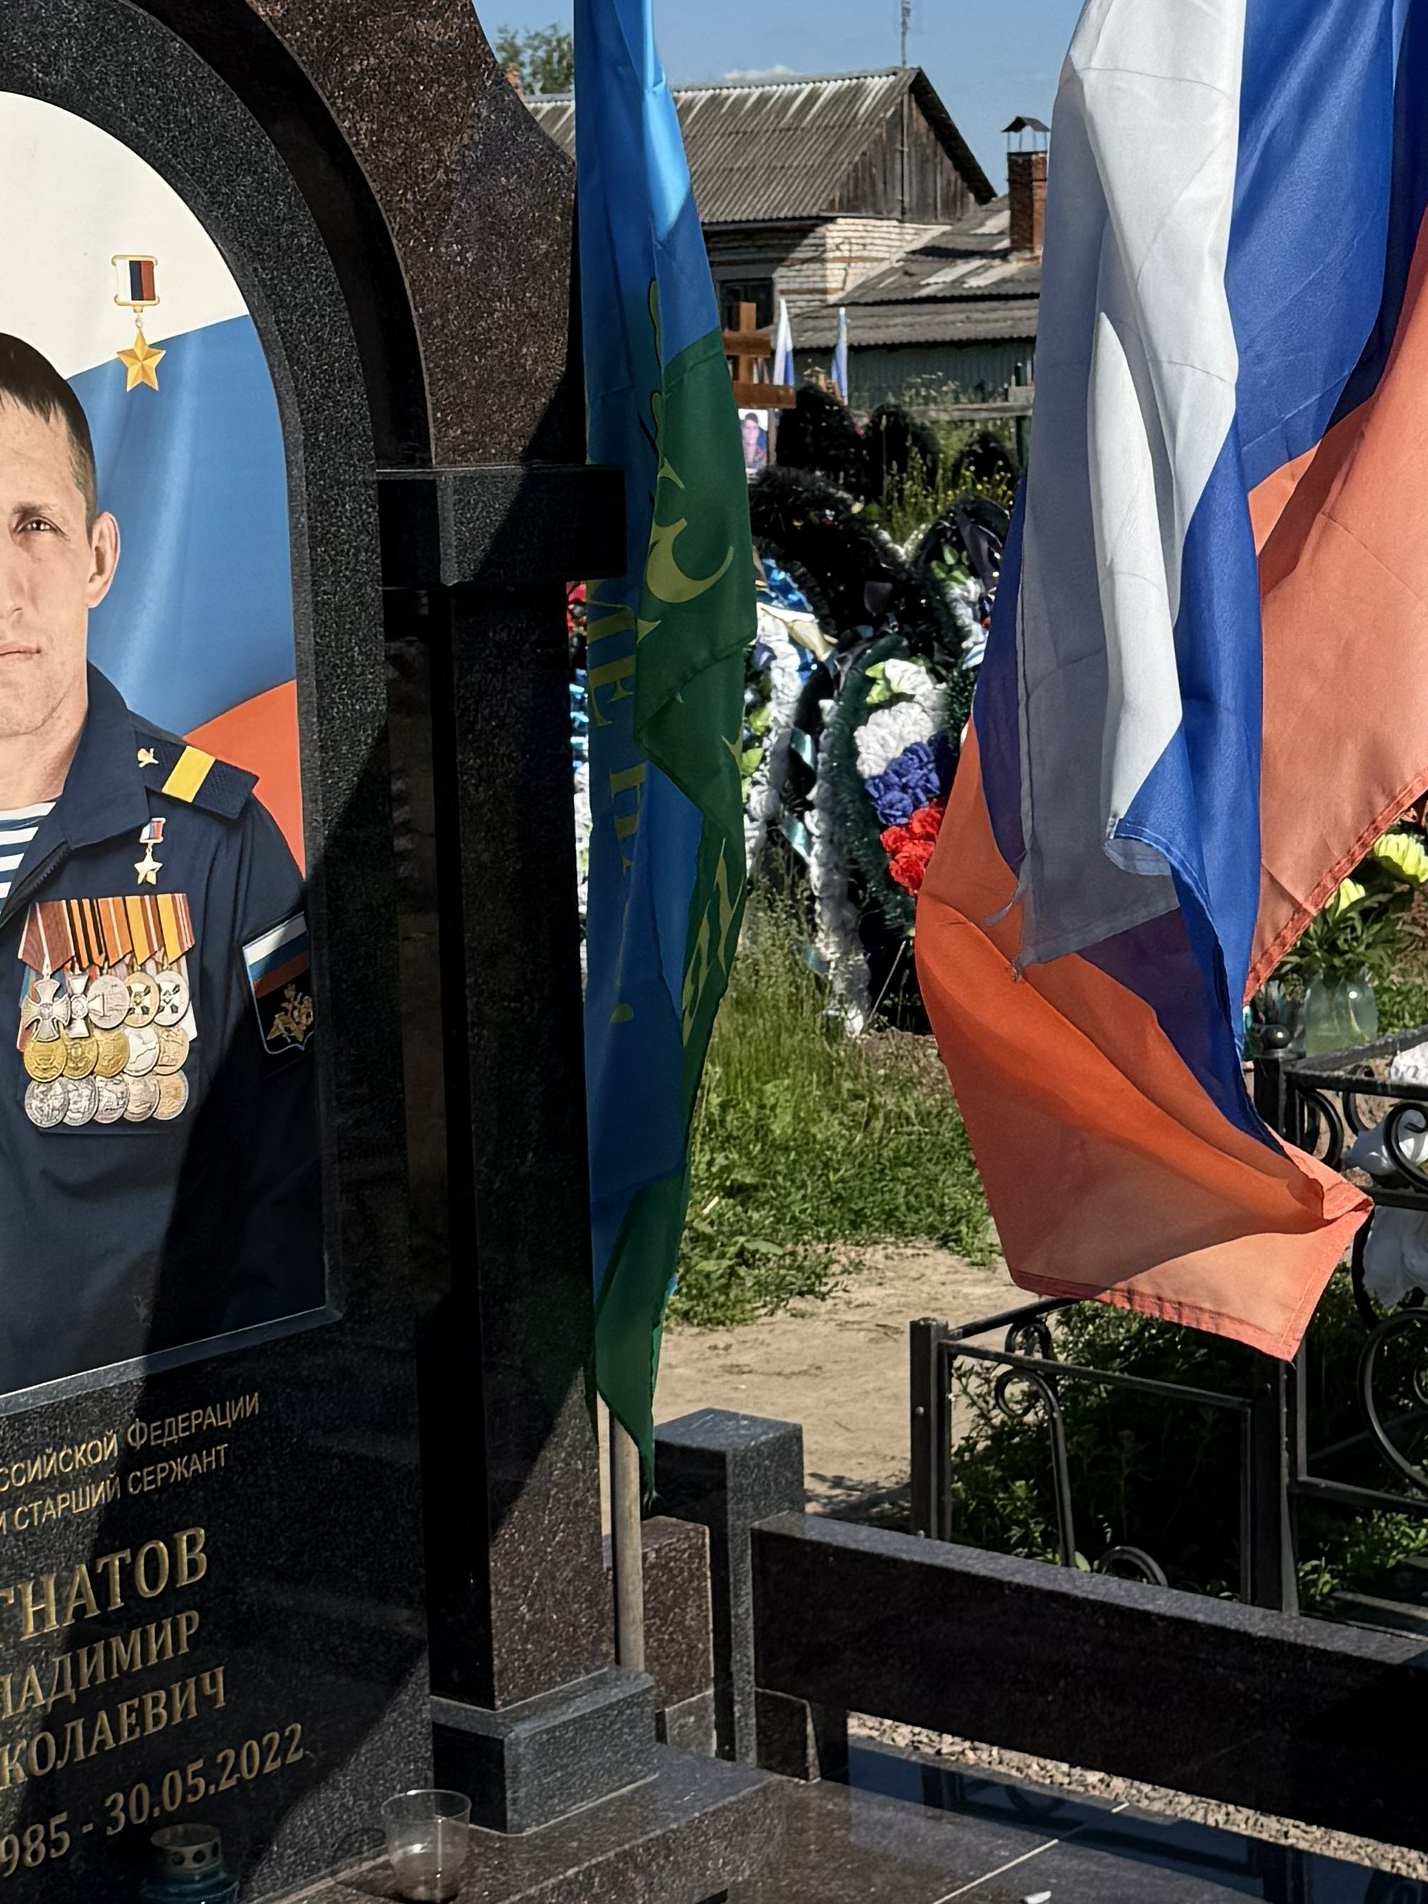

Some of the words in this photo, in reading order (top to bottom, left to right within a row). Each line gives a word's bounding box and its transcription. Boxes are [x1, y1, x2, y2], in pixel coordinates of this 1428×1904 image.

[13, 1471, 121, 1530] СТАРШИЙ
[127, 1444, 228, 1495] СЕРЖАНТ
[104, 1721, 304, 1836] 30.05.2022
